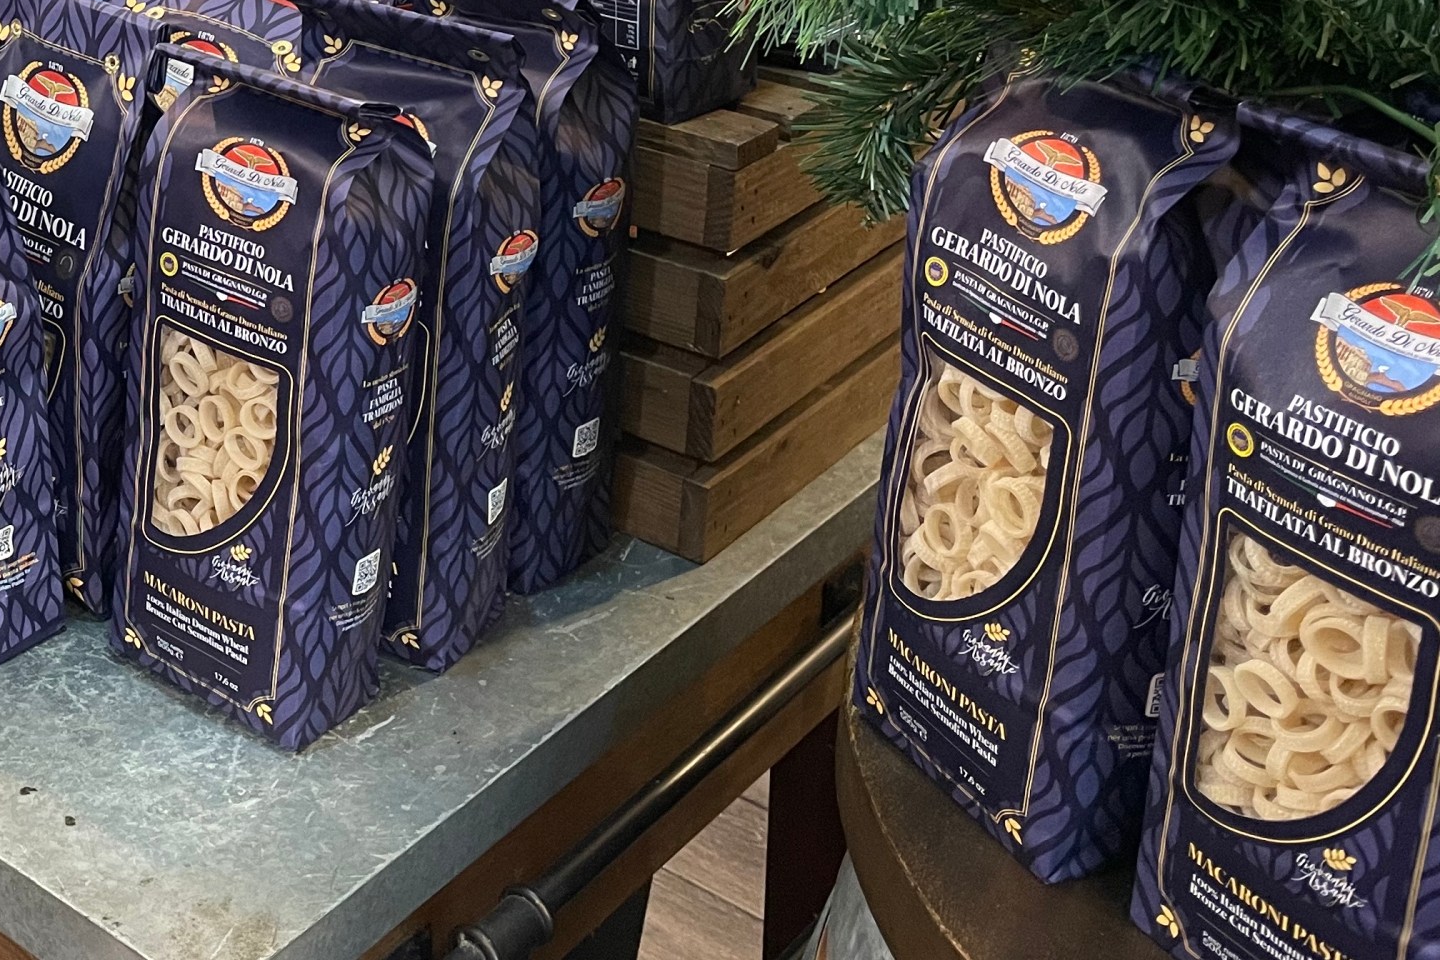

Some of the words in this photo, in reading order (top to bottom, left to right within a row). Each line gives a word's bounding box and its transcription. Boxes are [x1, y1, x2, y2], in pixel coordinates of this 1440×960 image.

[212, 154, 246, 180] Gerardo
[1003, 146, 1041, 179] Gerardo
[36, 211, 88, 251] NOLA
[162, 226, 232, 269] GERARDO
[234, 251, 254, 275] DI
[254, 256, 294, 292] NOLA
[198, 224, 265, 260] PASTIFICIO
[980, 227, 1047, 279] PASTIFICIO
[931, 226, 1011, 283] GERARDO
[1010, 267, 1032, 295] DI
[1031, 280, 1082, 325] NOLA
[986, 287, 1030, 322] GRAGNANO
[161, 292, 216, 332] TRAFILATA
[234, 324, 288, 355] BRONZO
[1338, 302, 1386, 338] Gerardo
[922, 303, 984, 357] TRAFILATA
[1006, 356, 1067, 401] BRONZO
[1034, 352, 1068, 384] Italiano
[1230, 387, 1343, 462] GERARDO
[1344, 444, 1378, 479] DI
[1287, 393, 1401, 457] PASTIFICIO
[1260, 440, 1291, 464] PASTA
[1307, 463, 1375, 507] GRAGNANO
[1226, 474, 1316, 544] TRAFILATA
[1317, 529, 1347, 561] AL
[1347, 539, 1439, 601] BRONZO
[1228, 462, 1253, 485] Pasta
[1266, 483, 1303, 518] Semola
[1317, 511, 1355, 544] Grano
[1356, 531, 1388, 561] Duro
[1389, 543, 1440, 580] Italiano
[143, 570, 211, 622] MACARONI
[210, 607, 256, 642] PASTA
[146, 601, 172, 623] Bronze
[172, 614, 187, 633] Cut
[187, 623, 224, 652] Semolina
[165, 602, 191, 623] Italian
[192, 613, 220, 638] Durum
[220, 628, 250, 655] Wheat
[888, 627, 957, 701] MACARONI
[958, 690, 1007, 741] PASTA
[929, 699, 971, 747] Semolina
[971, 738, 997, 767] Pasta
[935, 689, 966, 721] Durum
[968, 714, 999, 755] Wheat
[1187, 842, 1291, 932] MACARONI
[1189, 882, 1229, 922] Bronze
[1229, 910, 1250, 938] Cut
[1220, 891, 1258, 926] Italian
